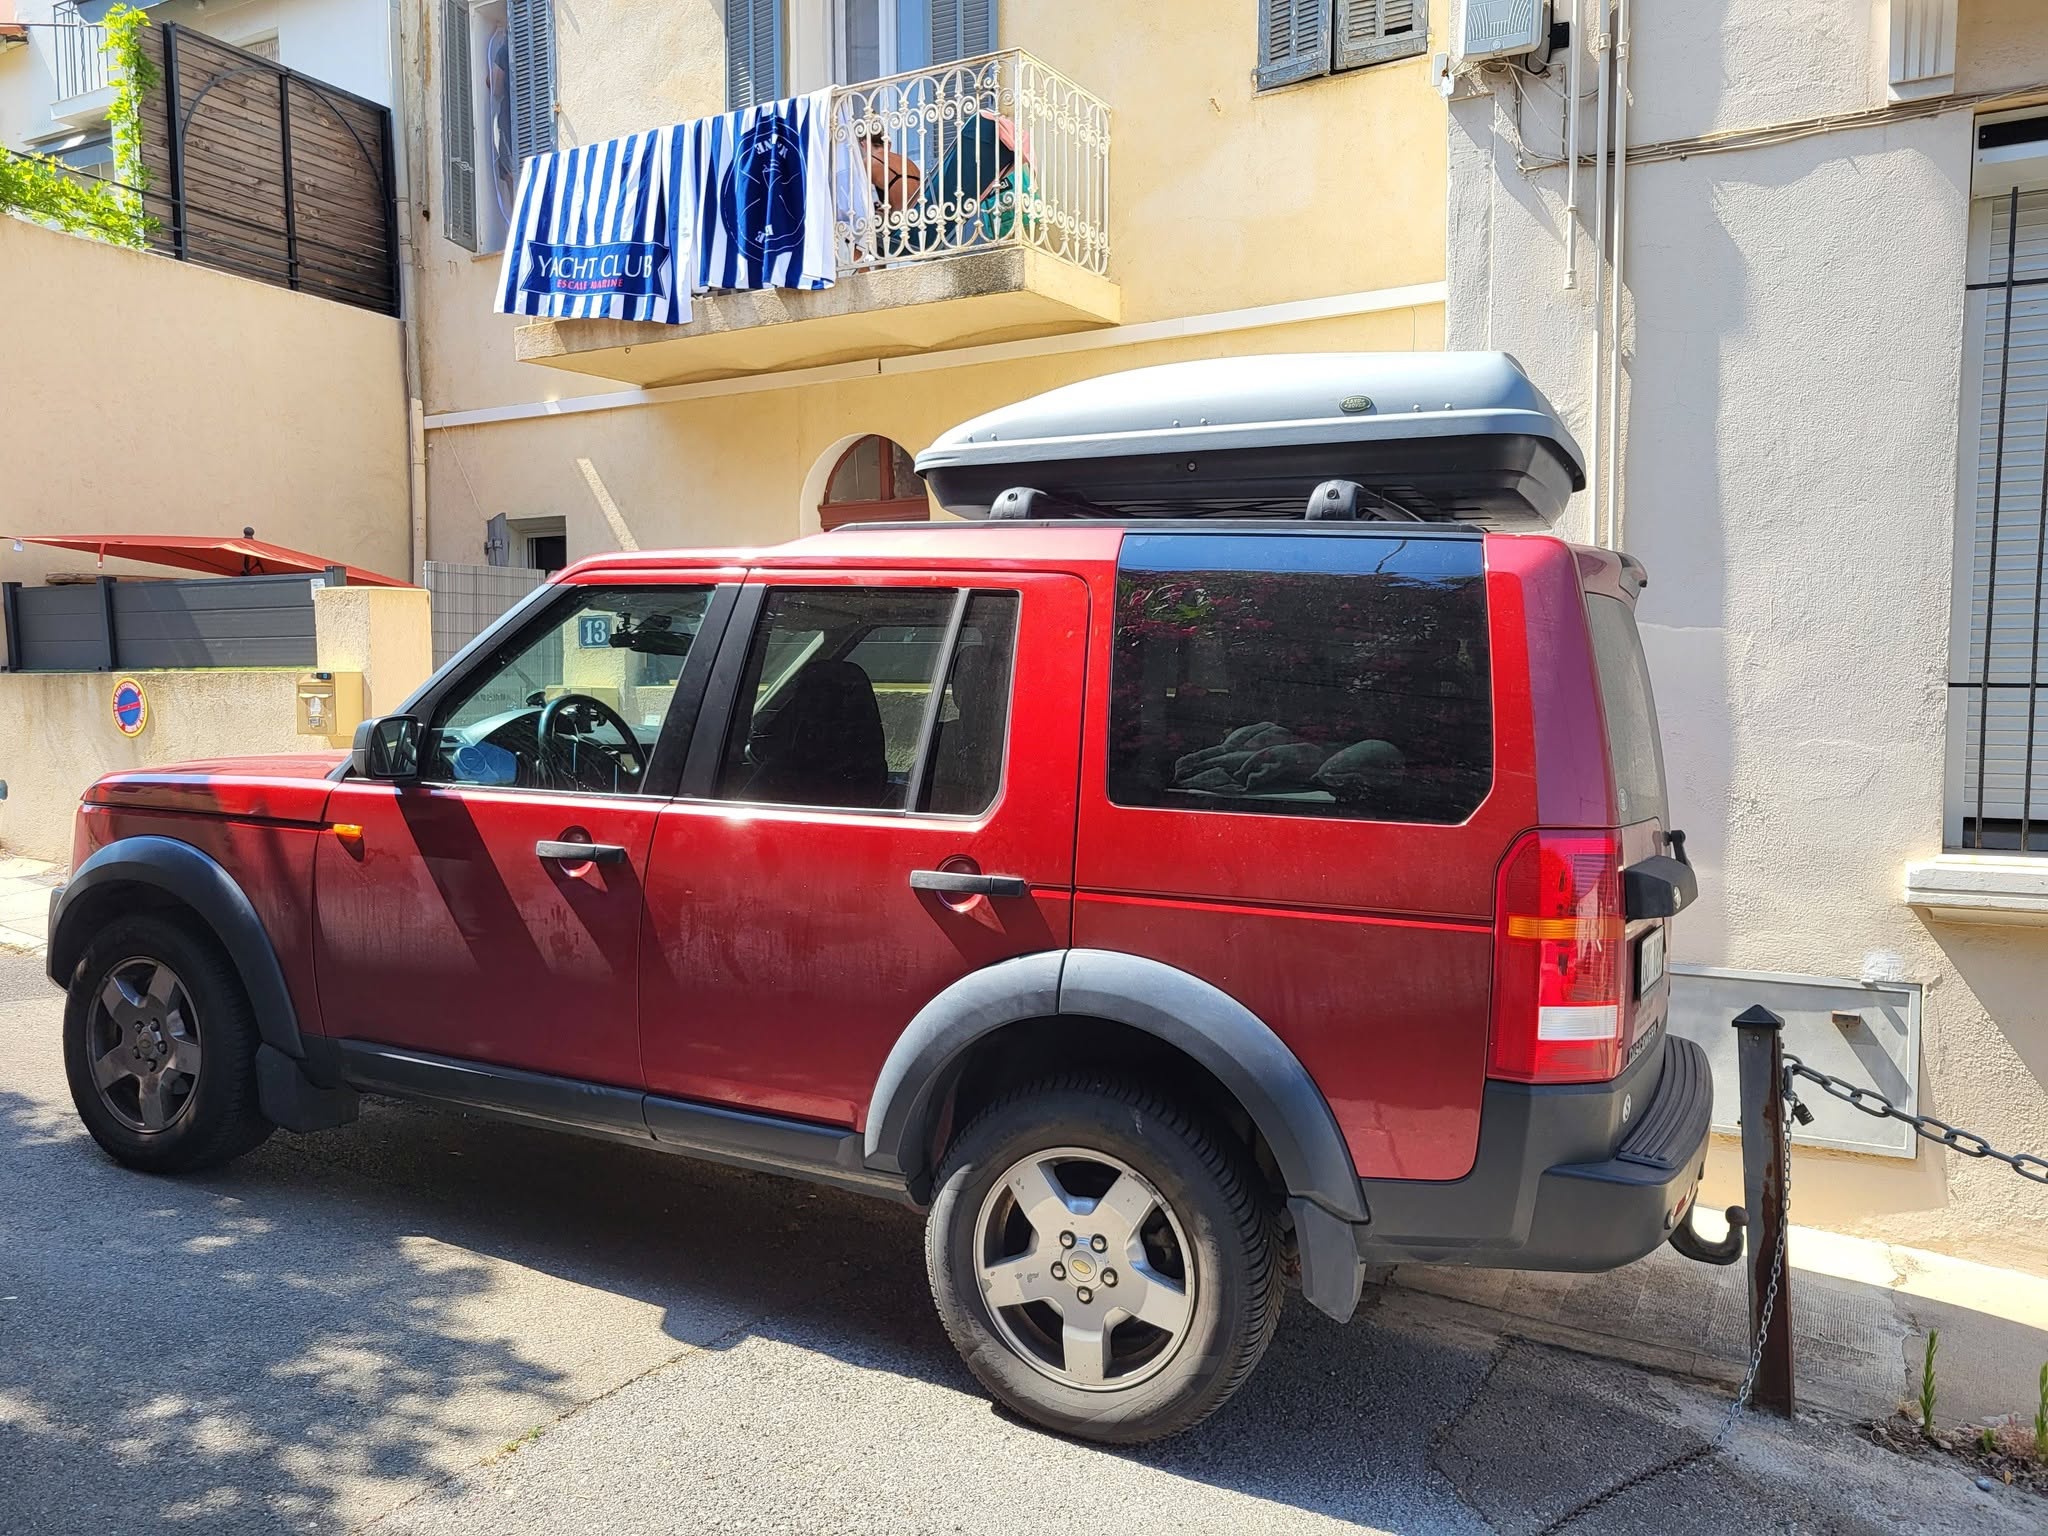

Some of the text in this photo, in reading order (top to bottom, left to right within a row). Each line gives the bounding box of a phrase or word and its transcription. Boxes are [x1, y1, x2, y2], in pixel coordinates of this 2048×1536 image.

[538, 255, 653, 279] YACHT CLUB
[556, 278, 624, 291] ESCALE MARINE
[585, 620, 605, 643] 13
